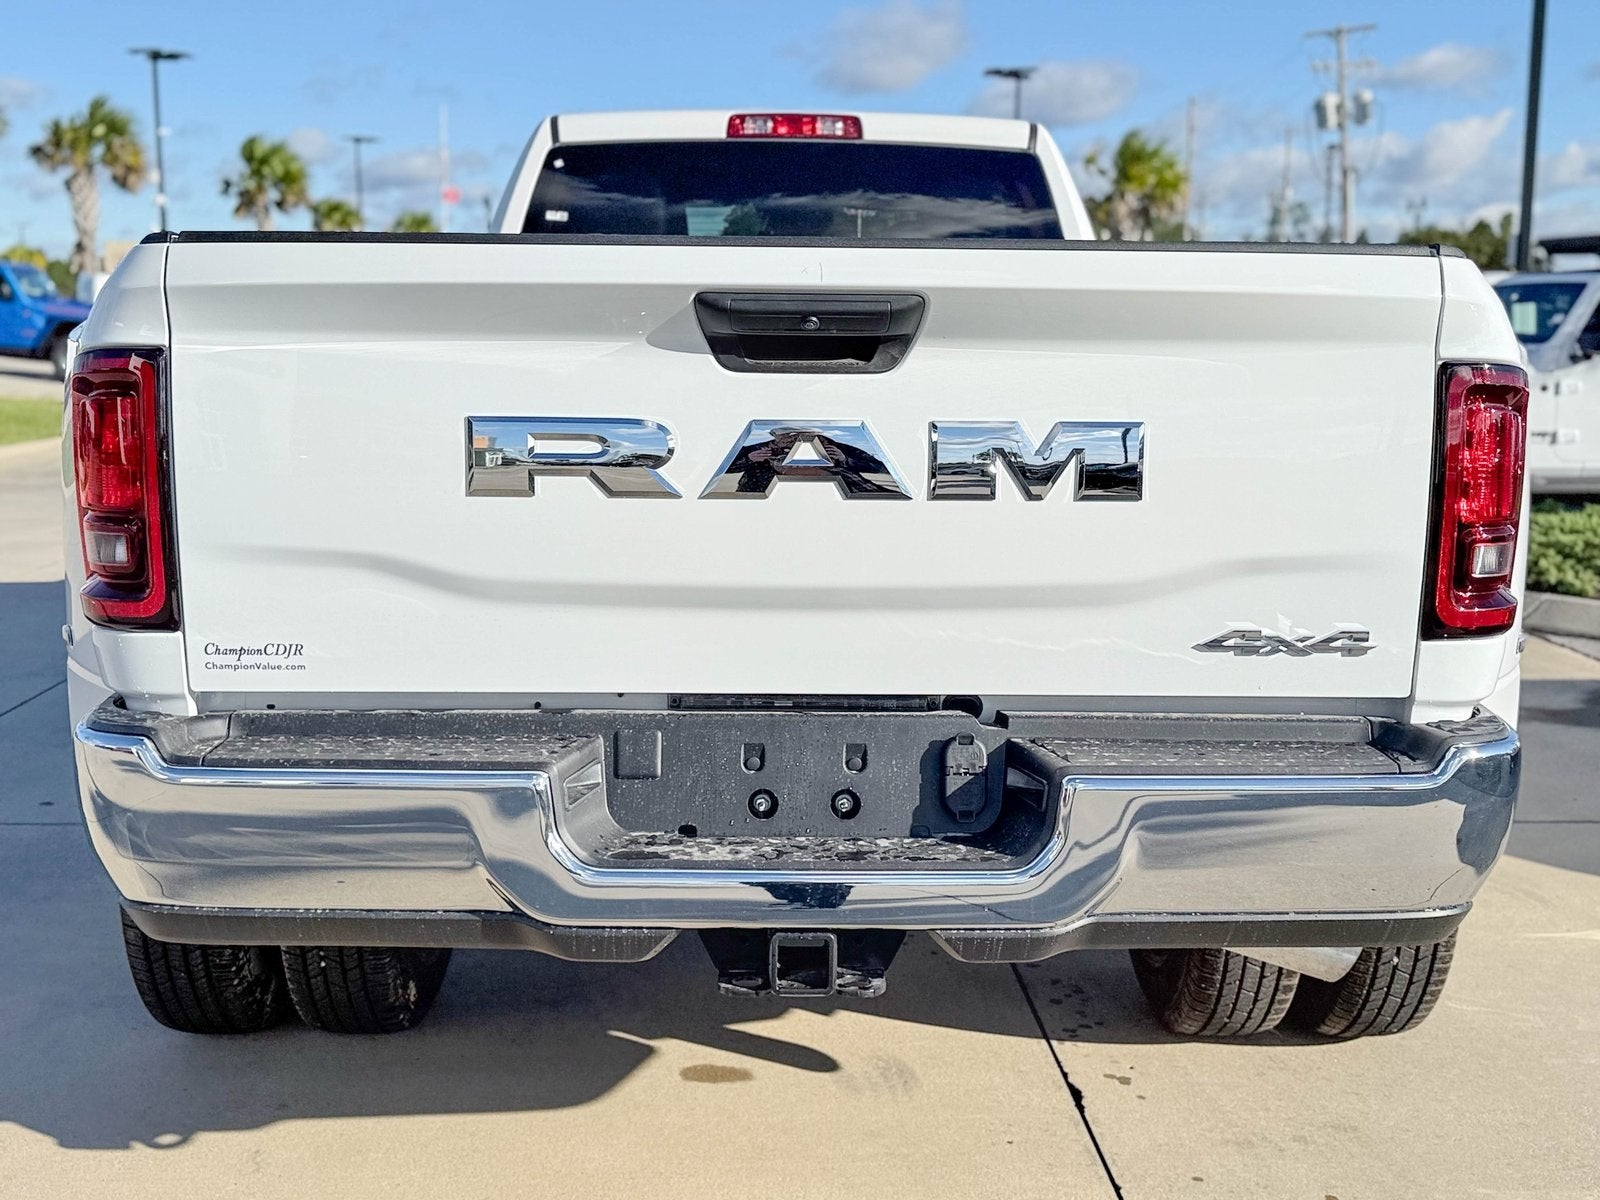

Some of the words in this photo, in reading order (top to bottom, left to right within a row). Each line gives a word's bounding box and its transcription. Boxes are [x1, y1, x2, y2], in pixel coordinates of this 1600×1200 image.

[465, 416, 1146, 501] RAM
[204, 642, 304, 661] ChampionCDJR
[204, 661, 306, 672] ChampionValue.com
